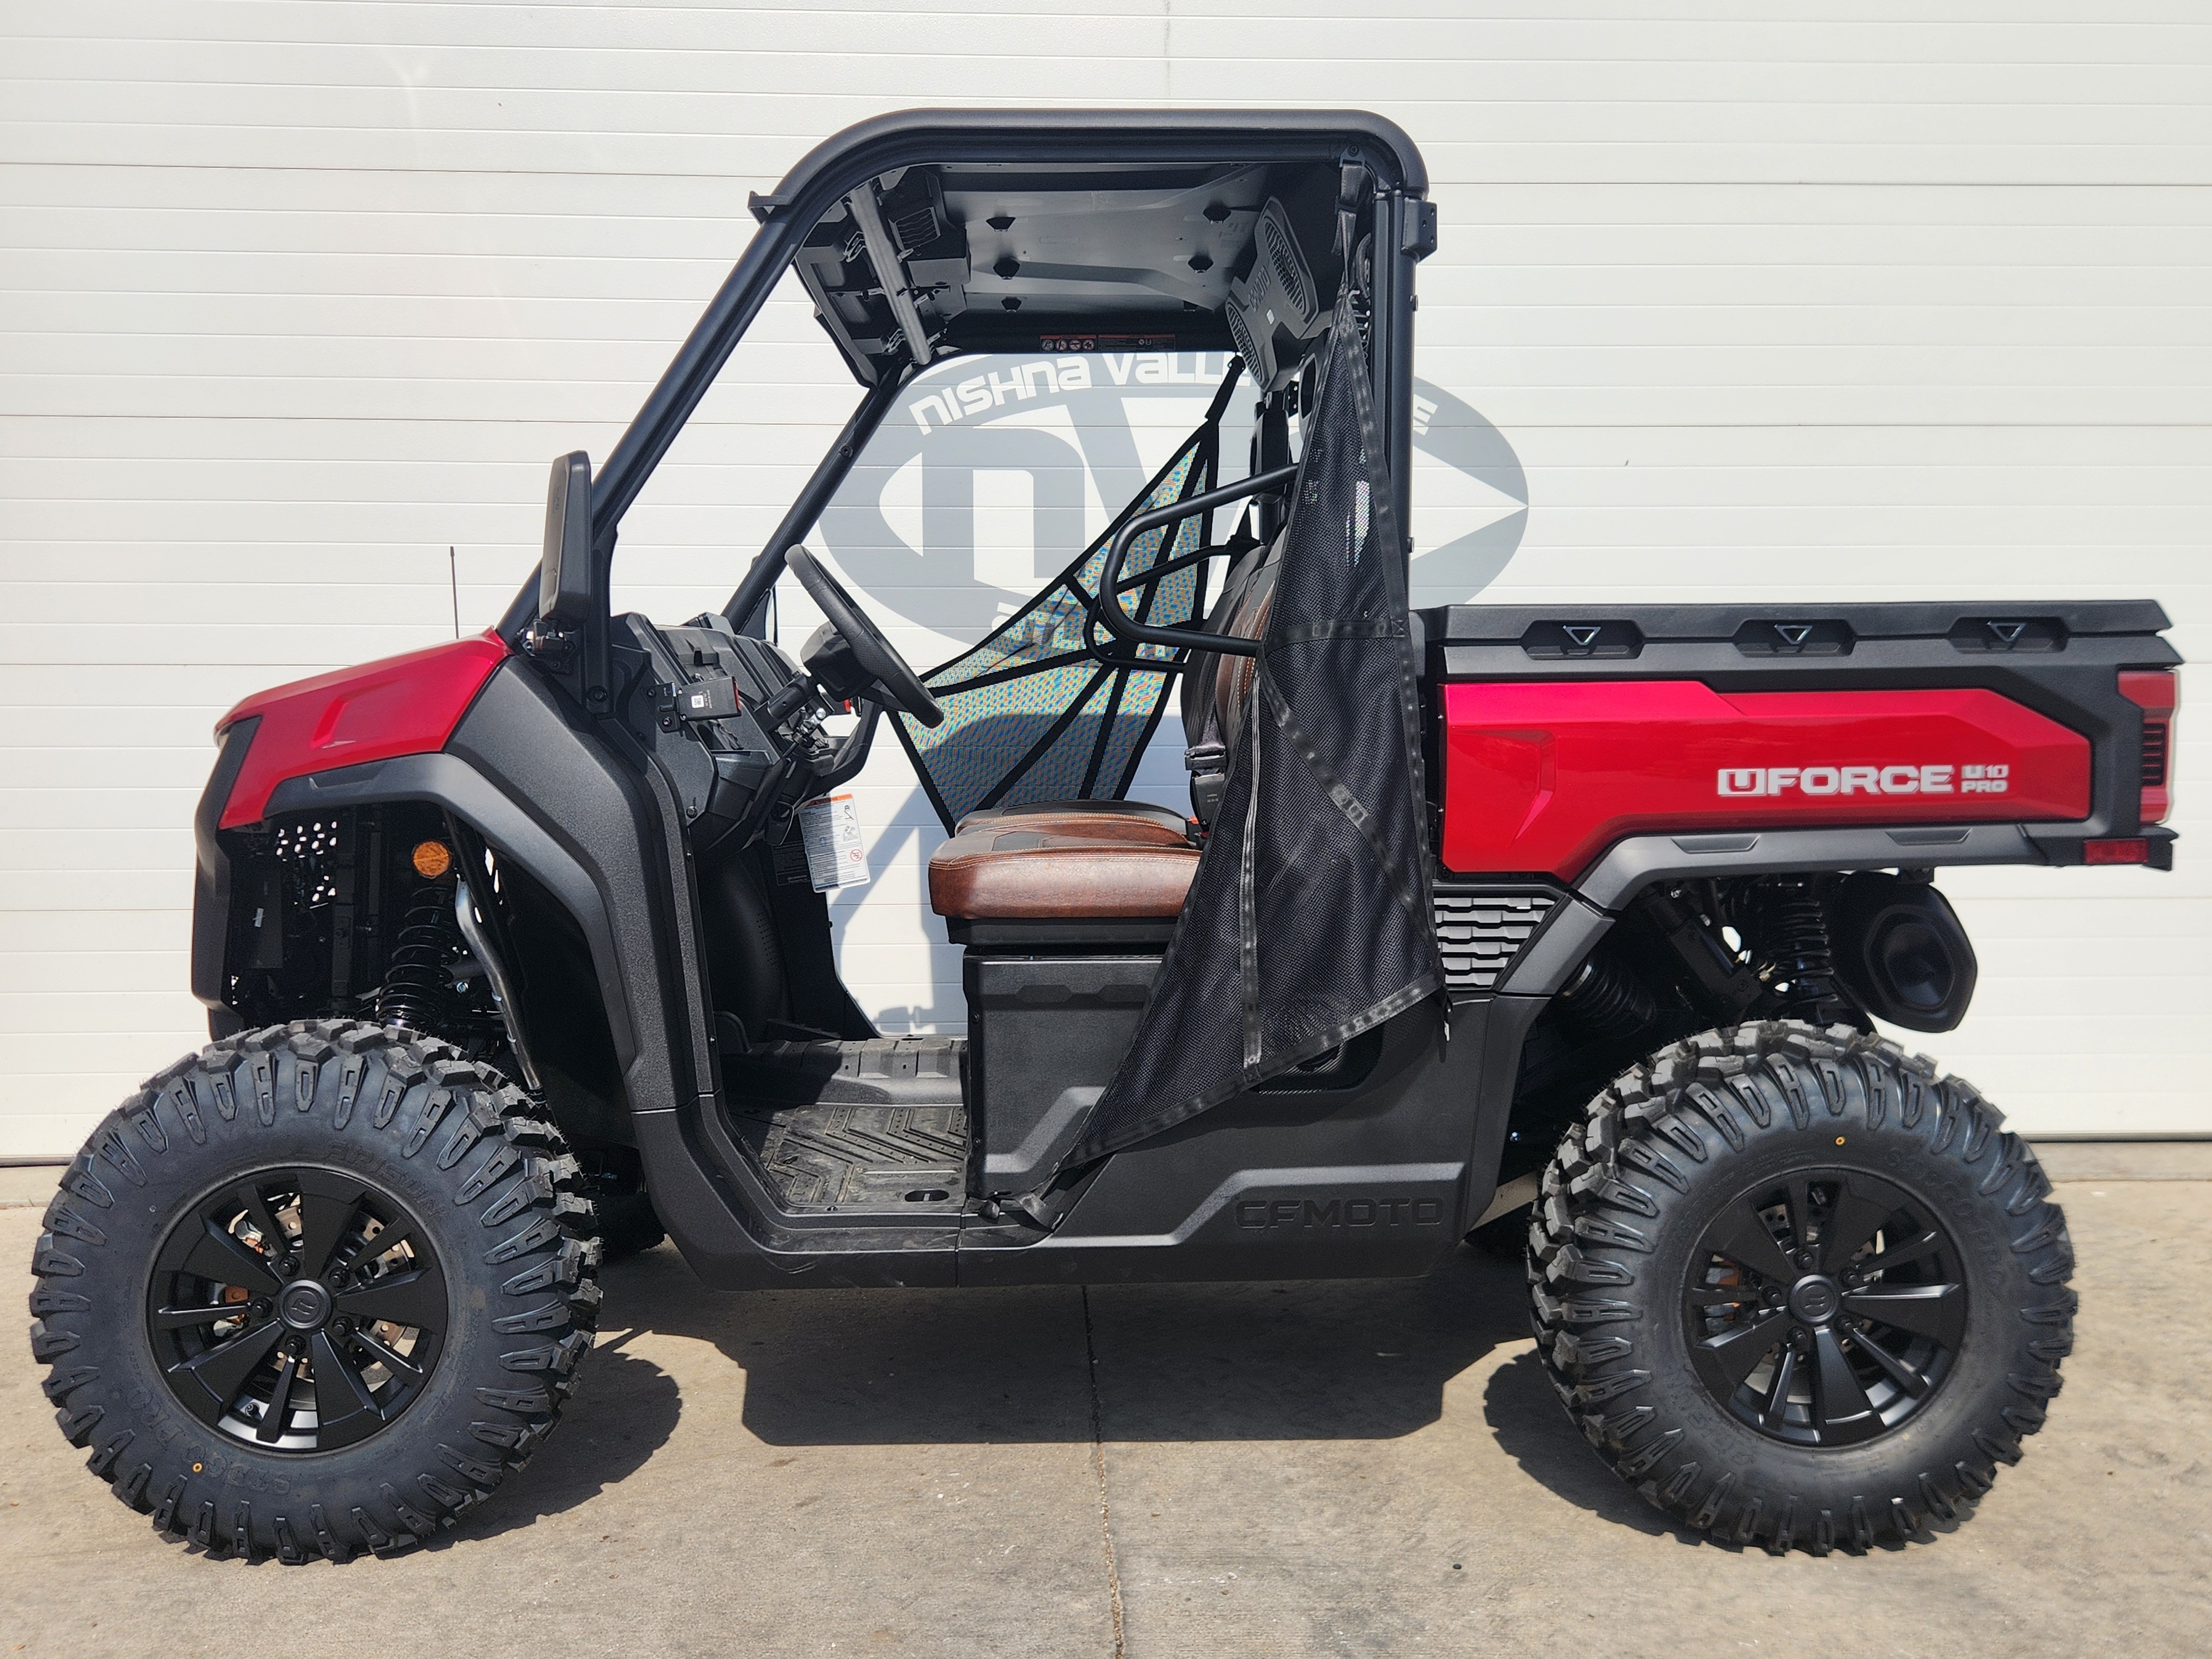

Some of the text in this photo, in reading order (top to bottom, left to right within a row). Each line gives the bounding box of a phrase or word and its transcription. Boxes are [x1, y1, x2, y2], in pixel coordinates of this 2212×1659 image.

[1718, 764, 2009, 797] UFORCE U10
[1961, 780, 2008, 793] PRO
[1235, 1197, 1444, 1229] CFMOTO
